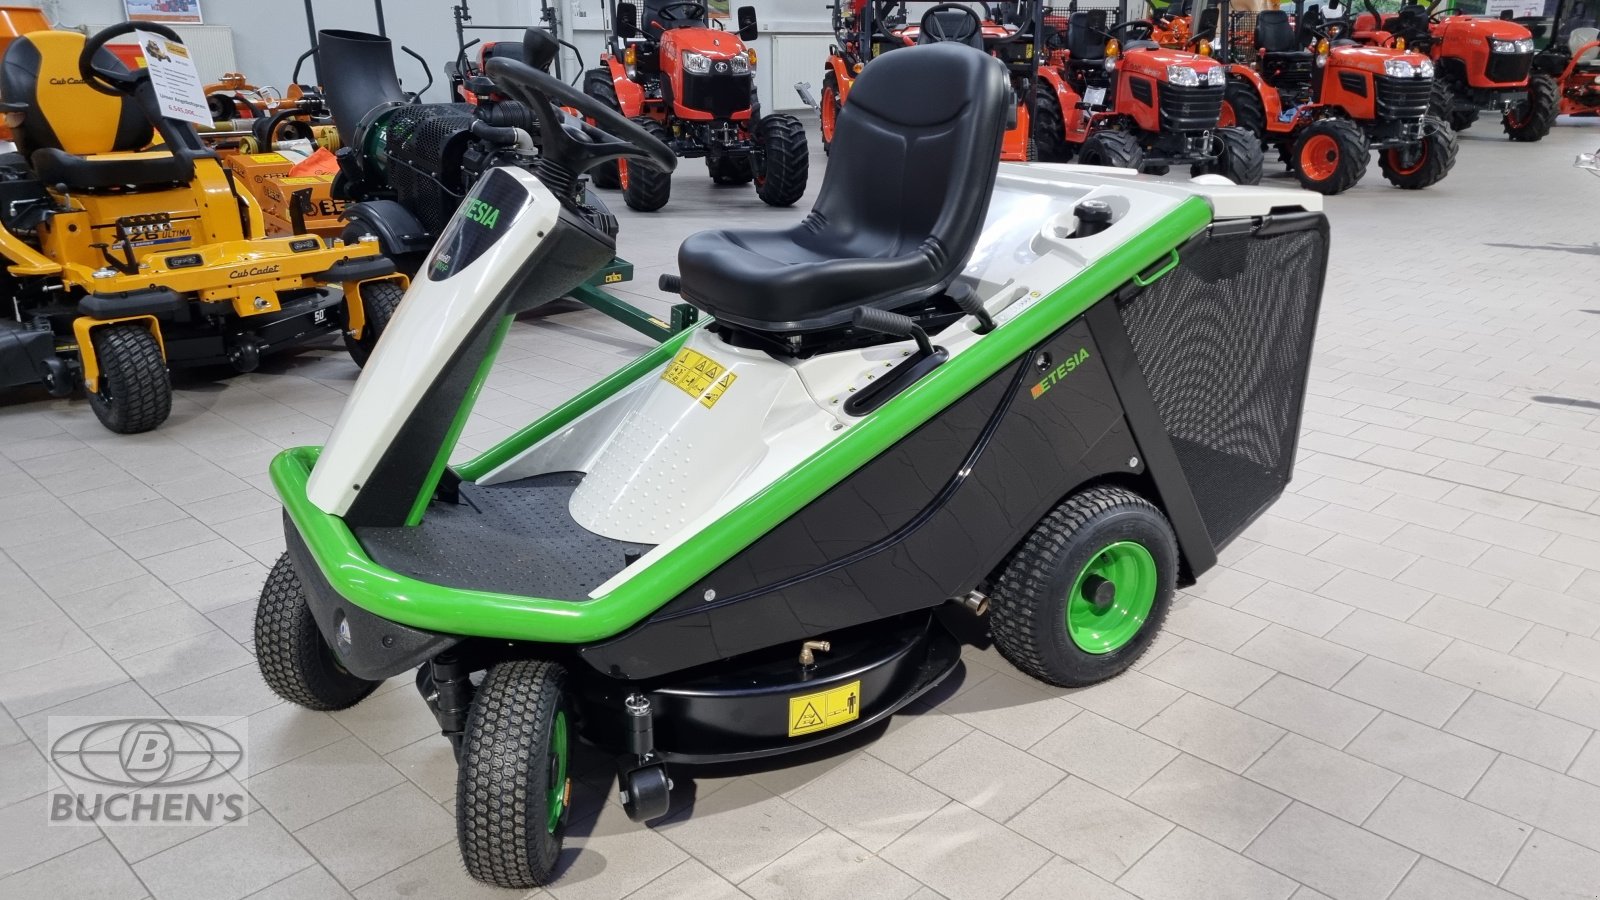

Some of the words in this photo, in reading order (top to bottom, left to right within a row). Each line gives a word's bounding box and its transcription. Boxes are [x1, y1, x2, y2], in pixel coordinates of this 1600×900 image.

[49, 77, 66, 85] Cub
[162, 229, 191, 239] ULTIMA
[229, 269, 248, 279] Cub
[249, 264, 279, 276] Cadet
[1034, 348, 1089, 396] ETESIA
